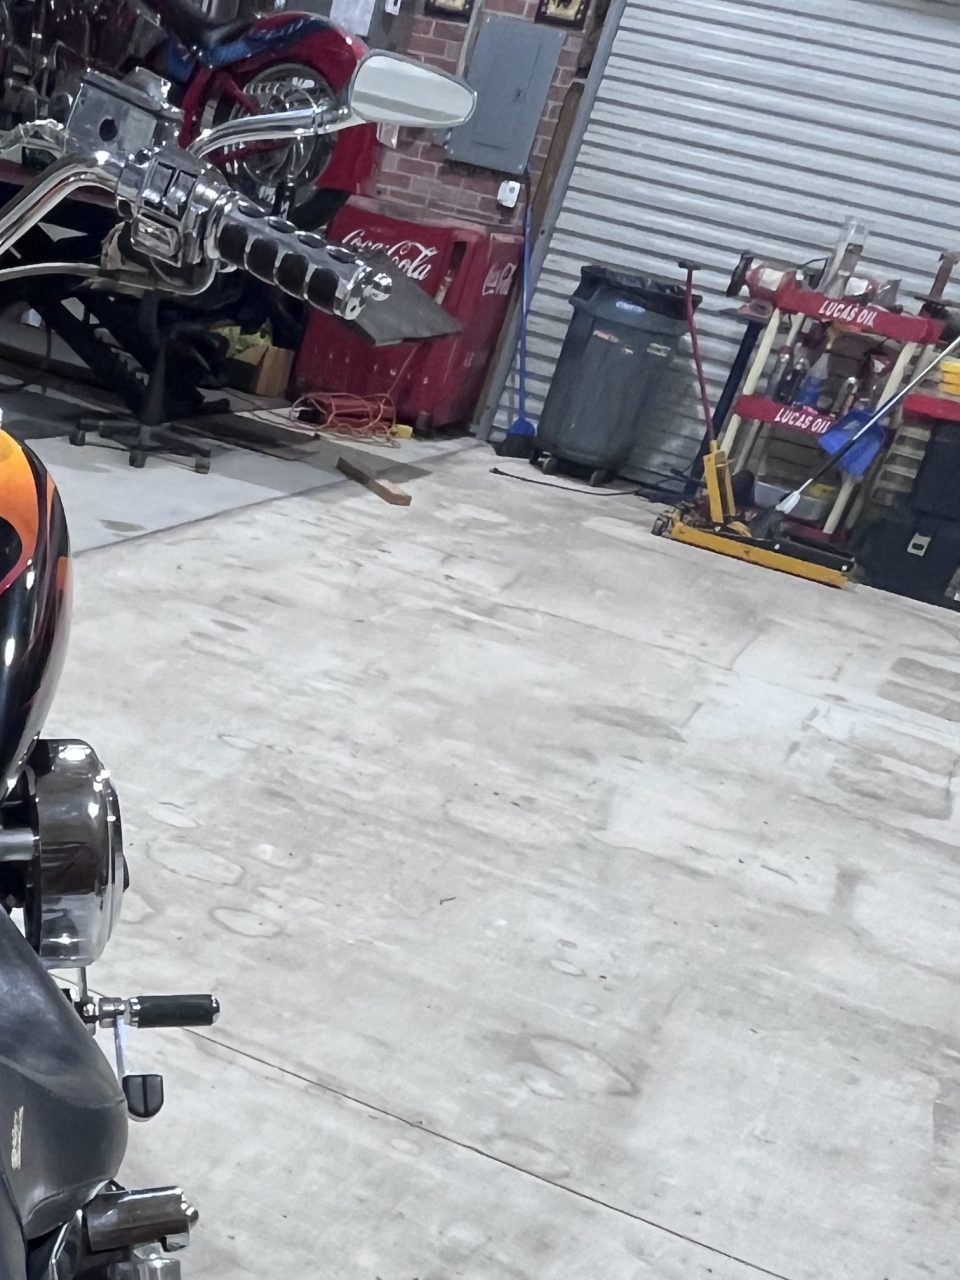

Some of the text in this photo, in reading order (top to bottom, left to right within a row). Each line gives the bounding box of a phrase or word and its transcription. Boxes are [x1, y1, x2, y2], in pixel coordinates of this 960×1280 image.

[818, 300, 877, 328] LUCAS OIL
[774, 407, 811, 429] LUCAS
